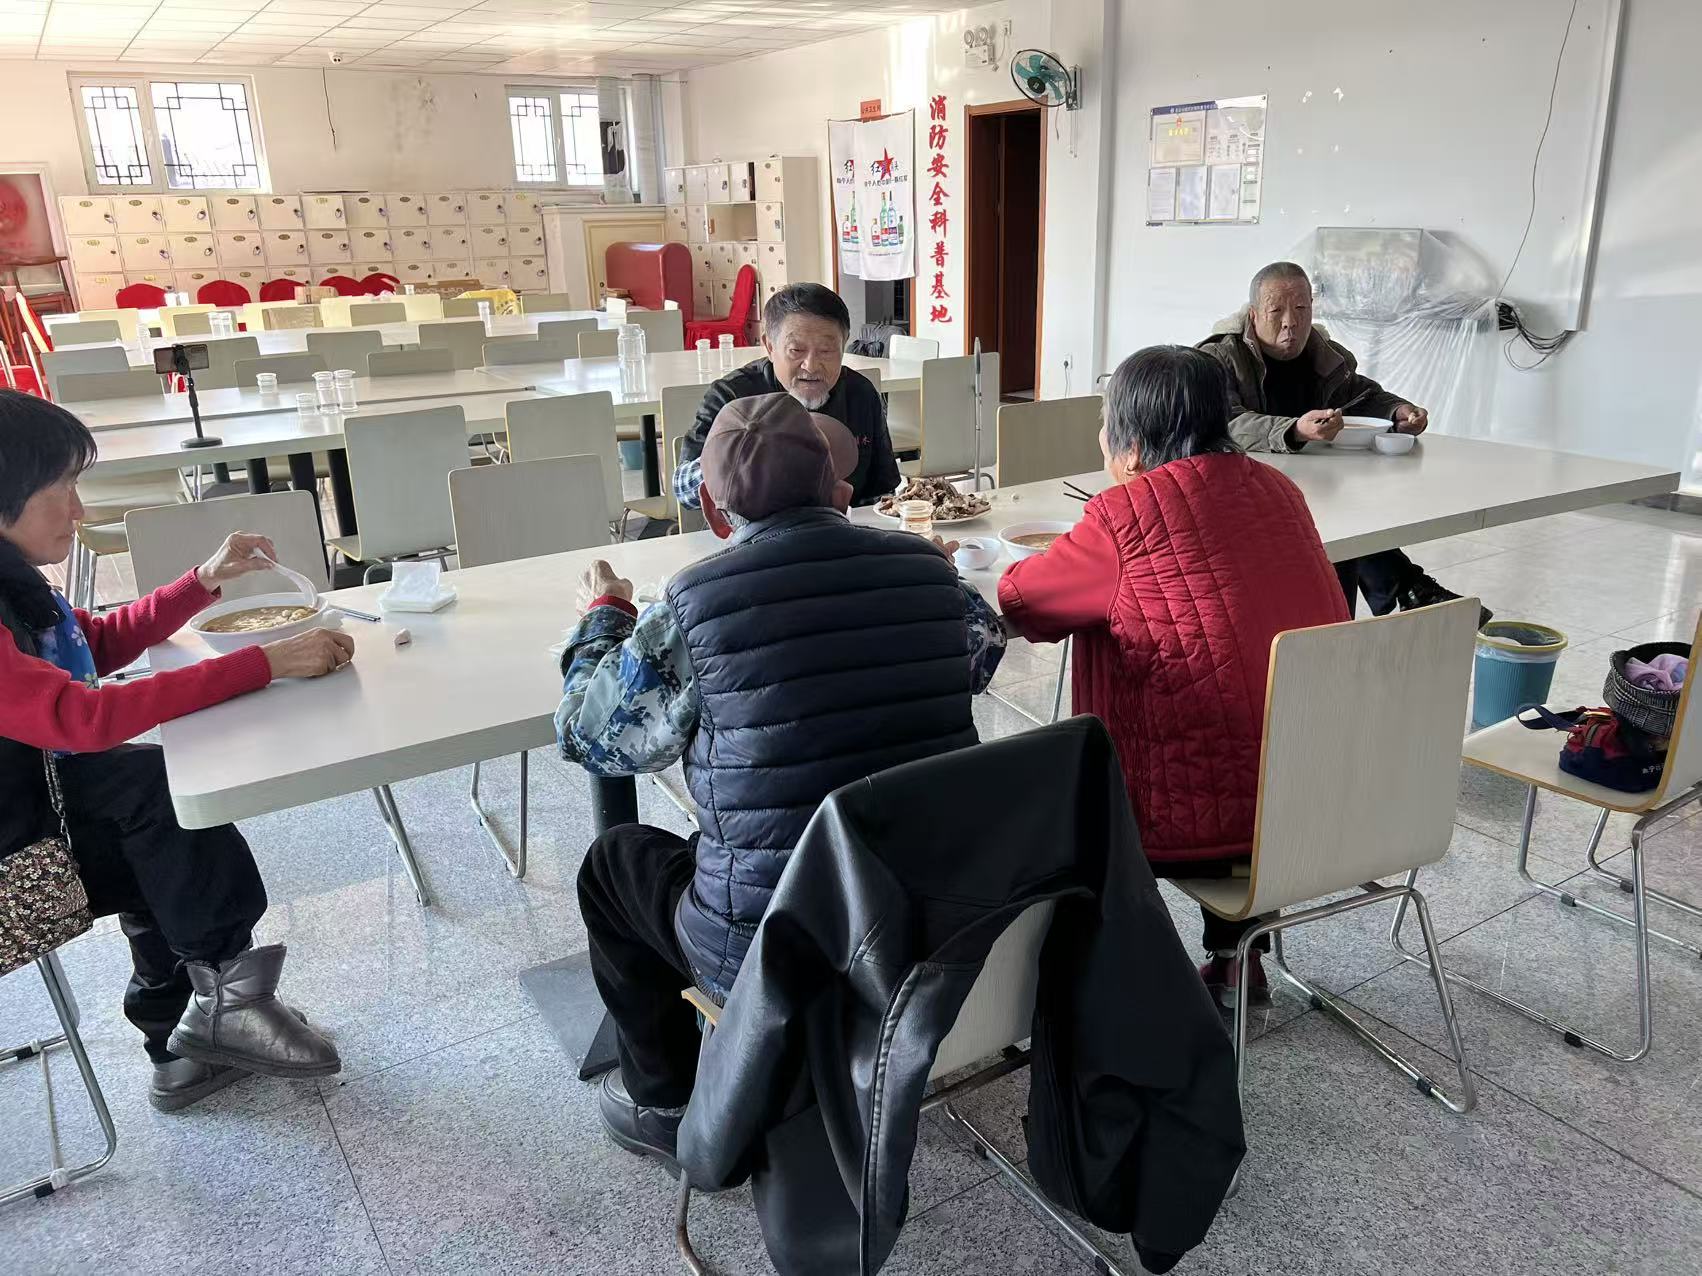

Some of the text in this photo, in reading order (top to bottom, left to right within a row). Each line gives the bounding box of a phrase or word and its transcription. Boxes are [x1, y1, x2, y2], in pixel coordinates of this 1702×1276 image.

[927, 94, 952, 324] 消防安全科普基地
